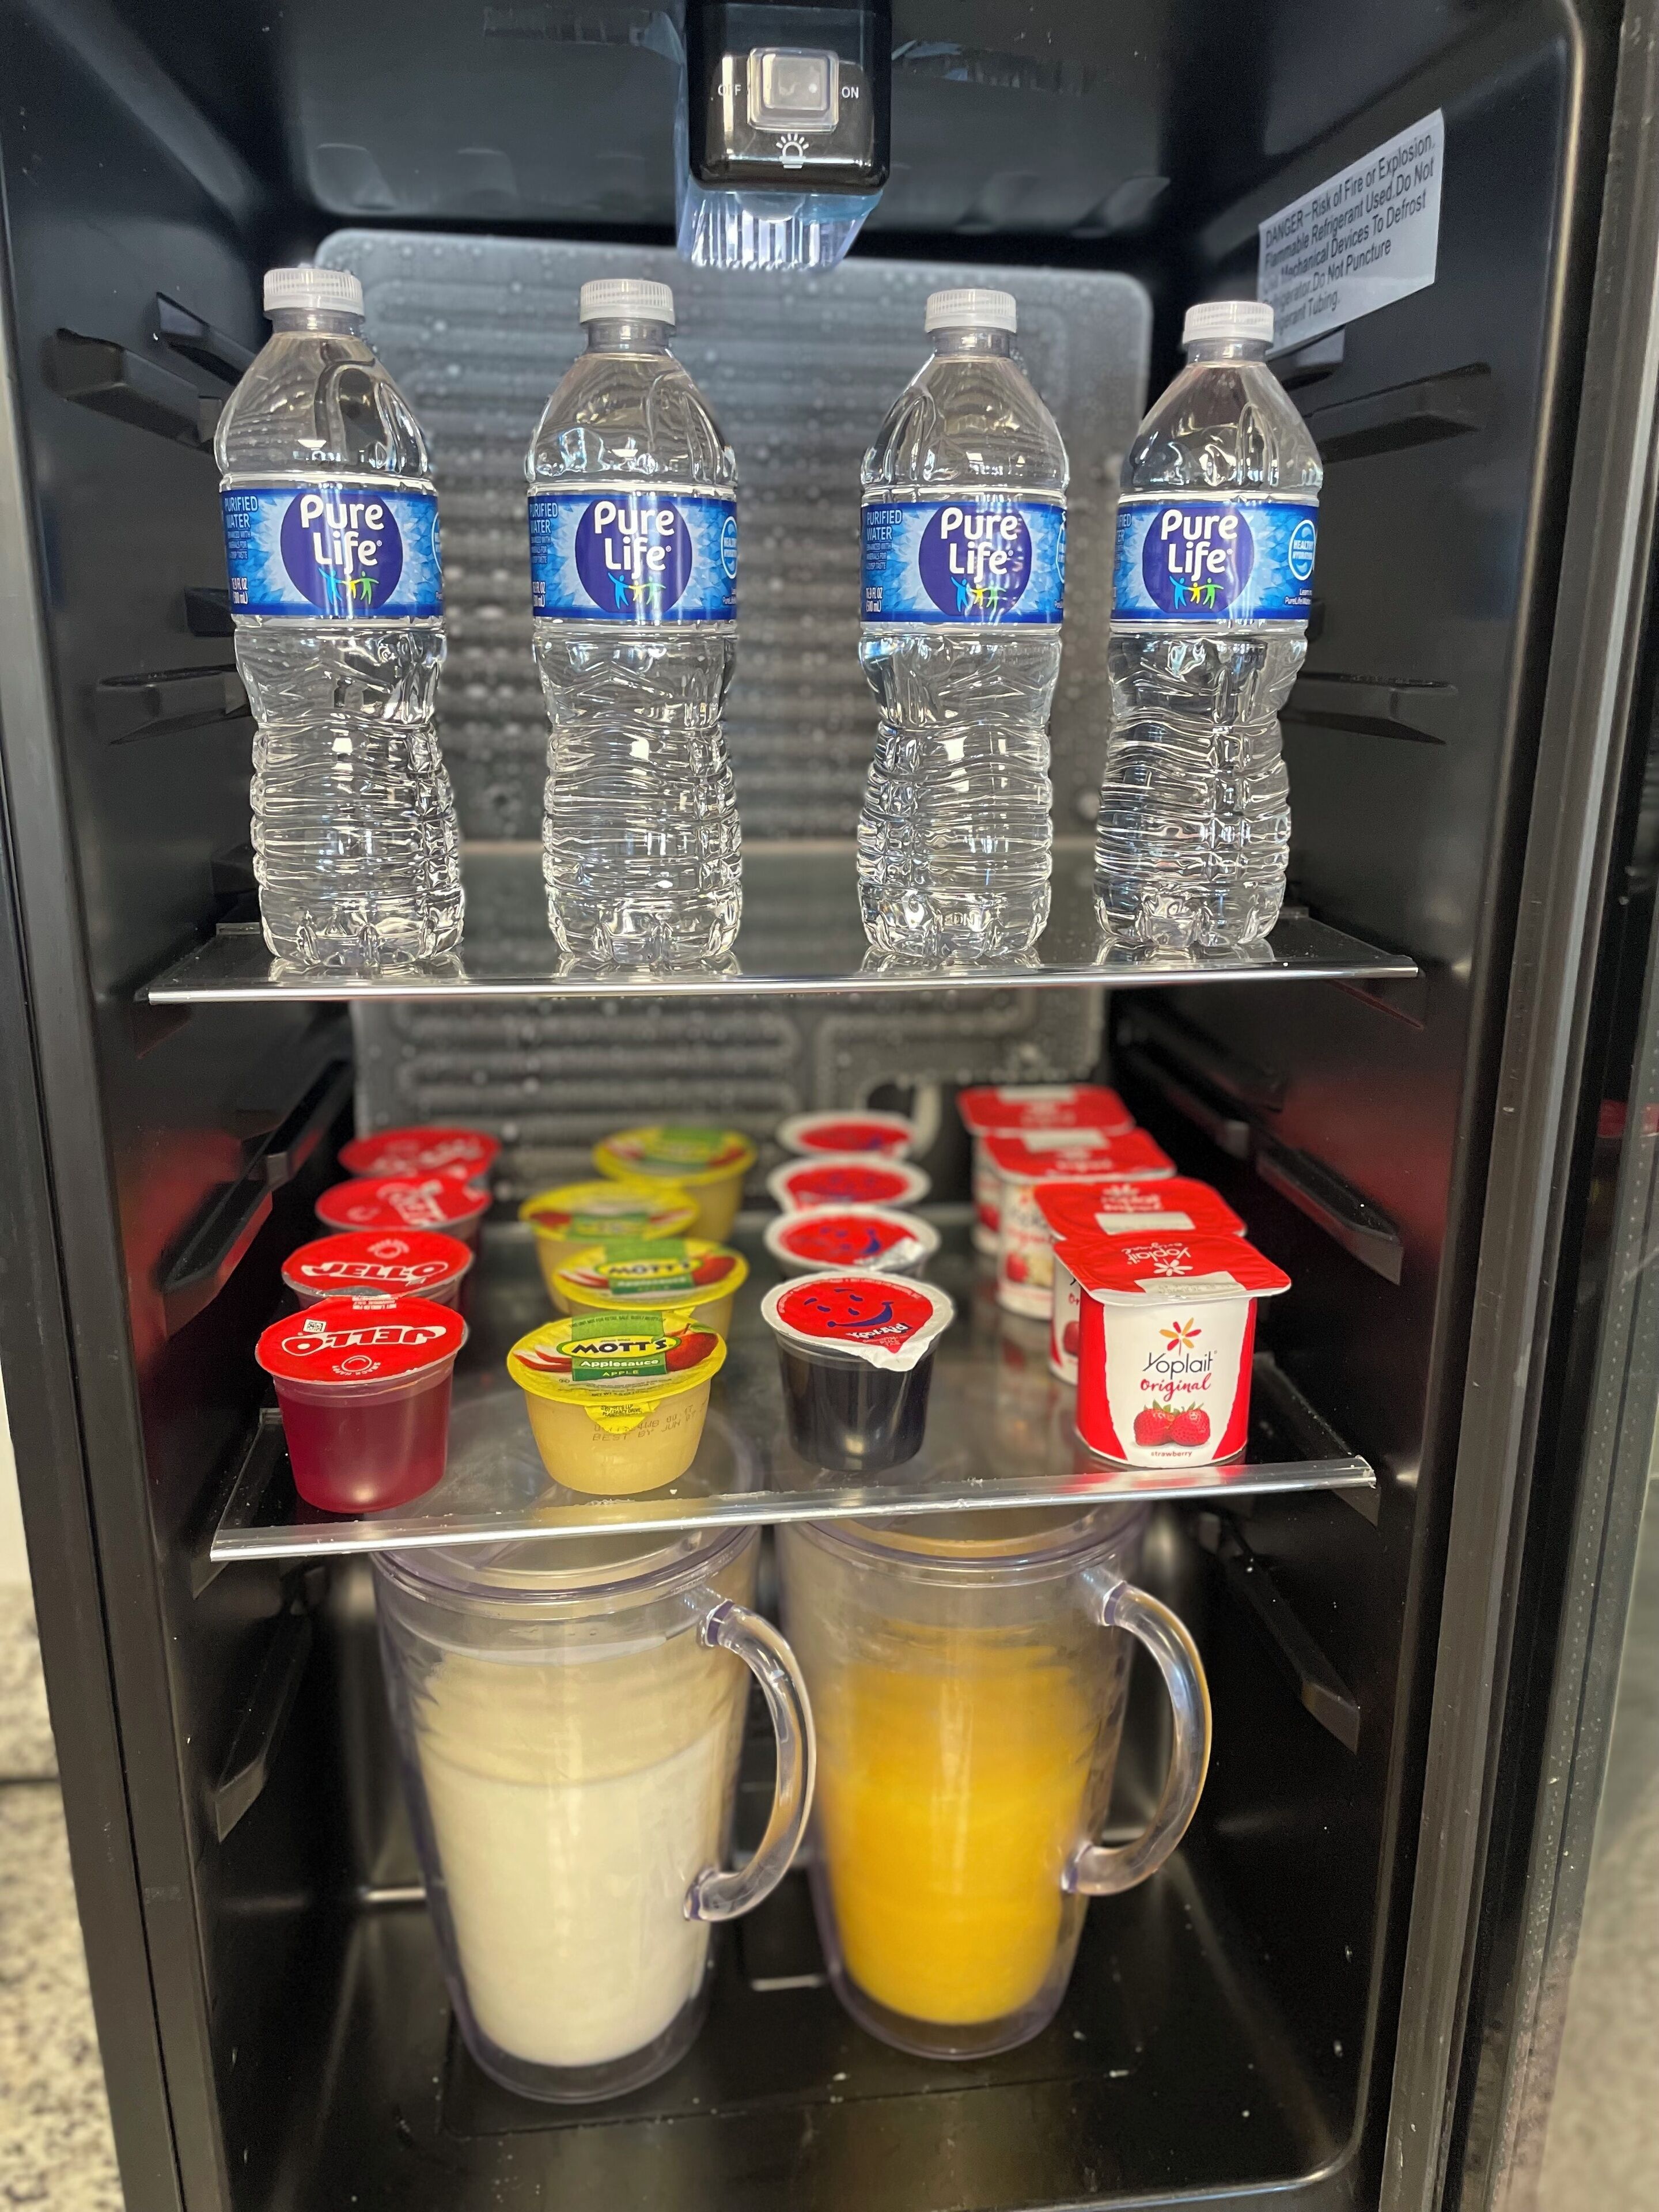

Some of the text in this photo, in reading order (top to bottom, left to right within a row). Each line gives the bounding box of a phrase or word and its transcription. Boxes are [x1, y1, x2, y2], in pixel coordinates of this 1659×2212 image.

[718, 85, 741, 96] OF
[842, 86, 859, 99] ON
[1266, 210, 1304, 249] DANGER
[1333, 184, 1343, 207] of
[1344, 176, 1363, 200] Fire
[1366, 168, 1376, 187] or
[1311, 198, 1363, 244] Refrigerant
[1414, 157, 1434, 187] Not
[1331, 225, 1369, 258] Devices
[1372, 214, 1384, 236] To
[1386, 188, 1426, 229] Defrost
[1328, 261, 1344, 285] Not
[1346, 240, 1392, 275] Puncture
[1308, 291, 1340, 317] Tubing.
[224, 495, 259, 512] PURIFIED
[300, 494, 385, 531] Pure
[593, 501, 675, 536] Pure
[866, 509, 903, 526] PURIFIED
[531, 519, 551, 534] ATER
[866, 526, 892, 541] WATER
[940, 507, 1018, 540] Pure
[1160, 509, 1239, 540] Pure
[313, 531, 378, 575] Life
[604, 536, 666, 579] Life
[949, 541, 1007, 584] Life
[1168, 541, 1226, 582] Life
[1127, 1247, 1191, 1265] Yoplait
[571, 1338, 668, 1354] MOTT'S
[580, 1359, 659, 1368] Applesauce
[1142, 1351, 1214, 1380] Yoplait
[592, 1433, 631, 1441] BEST
